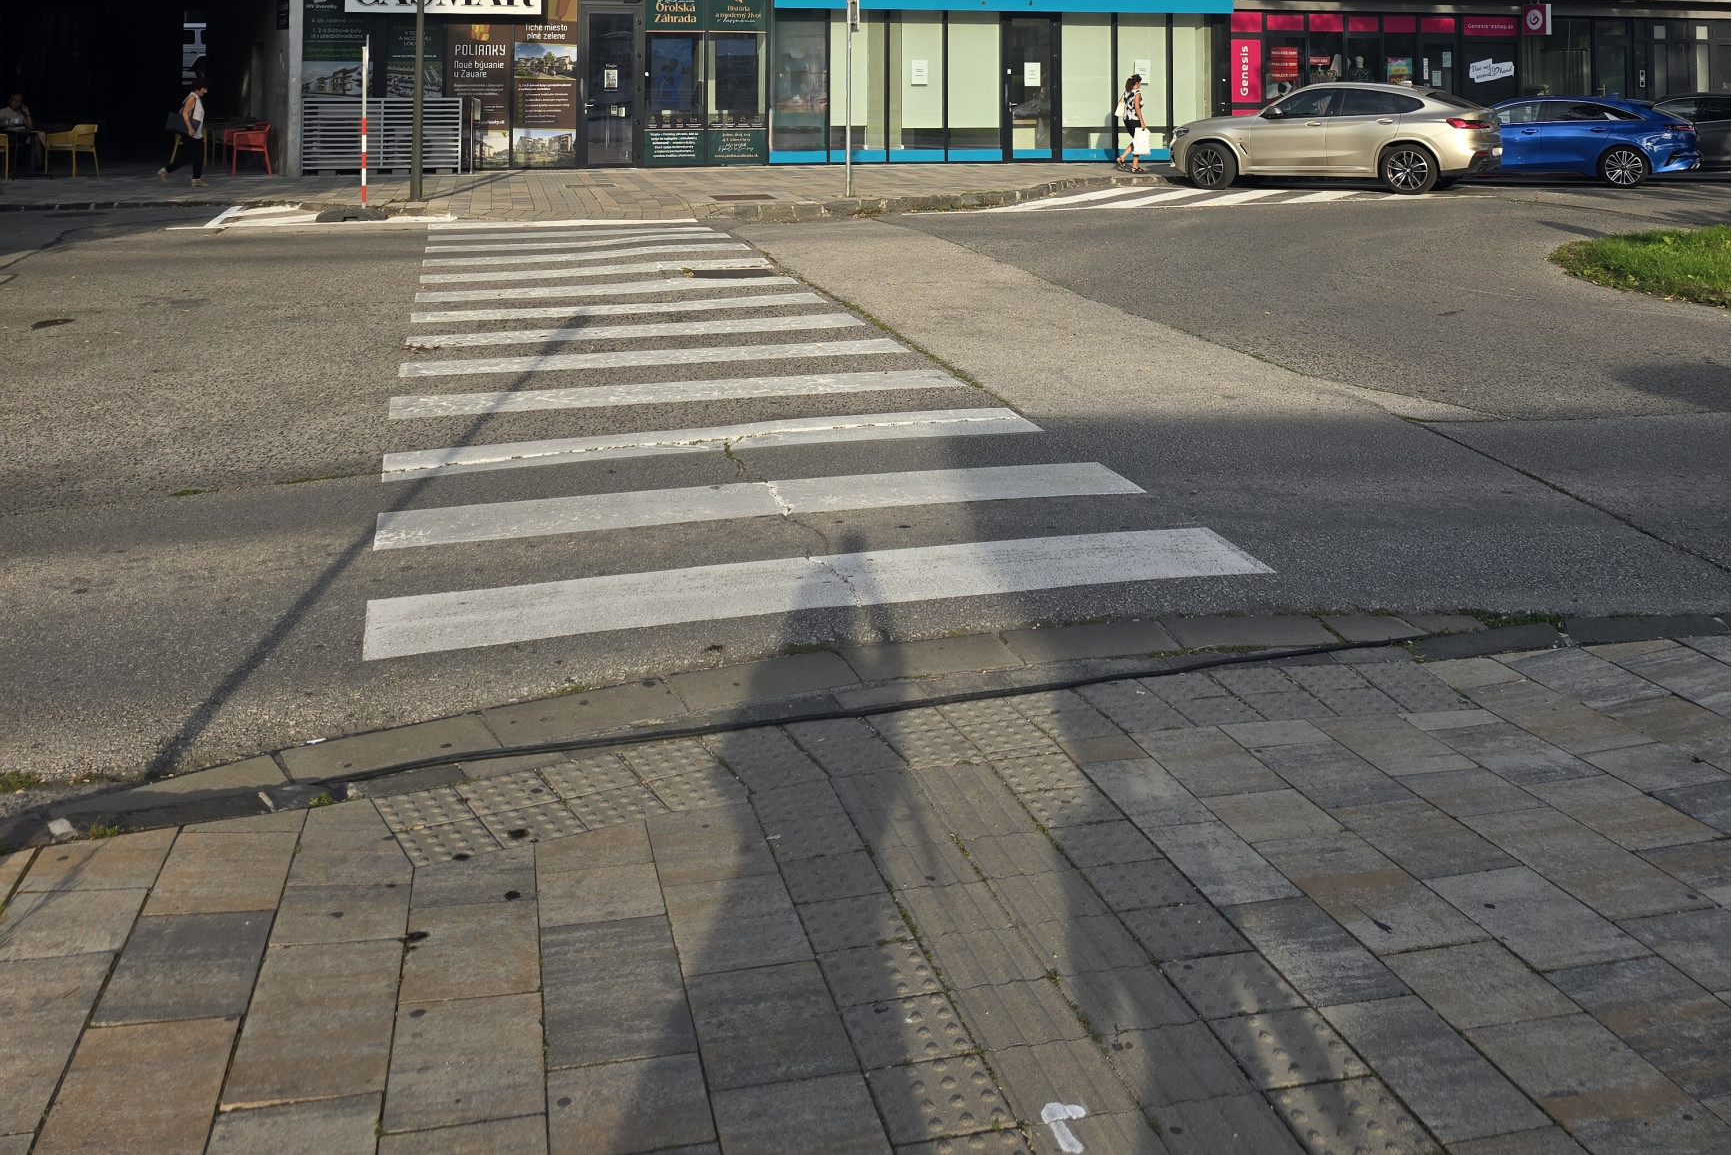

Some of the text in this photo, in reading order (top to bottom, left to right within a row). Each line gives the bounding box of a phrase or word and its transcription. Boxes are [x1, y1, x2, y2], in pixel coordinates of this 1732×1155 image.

[655, 2, 696, 13] Orolská
[654, 13, 697, 23] Záhrada
[545, 23, 568, 32] miesto
[526, 31, 566, 41] plné zelene
[454, 44, 506, 56] POLIANKY
[1240, 45, 1249, 97] Genesis
